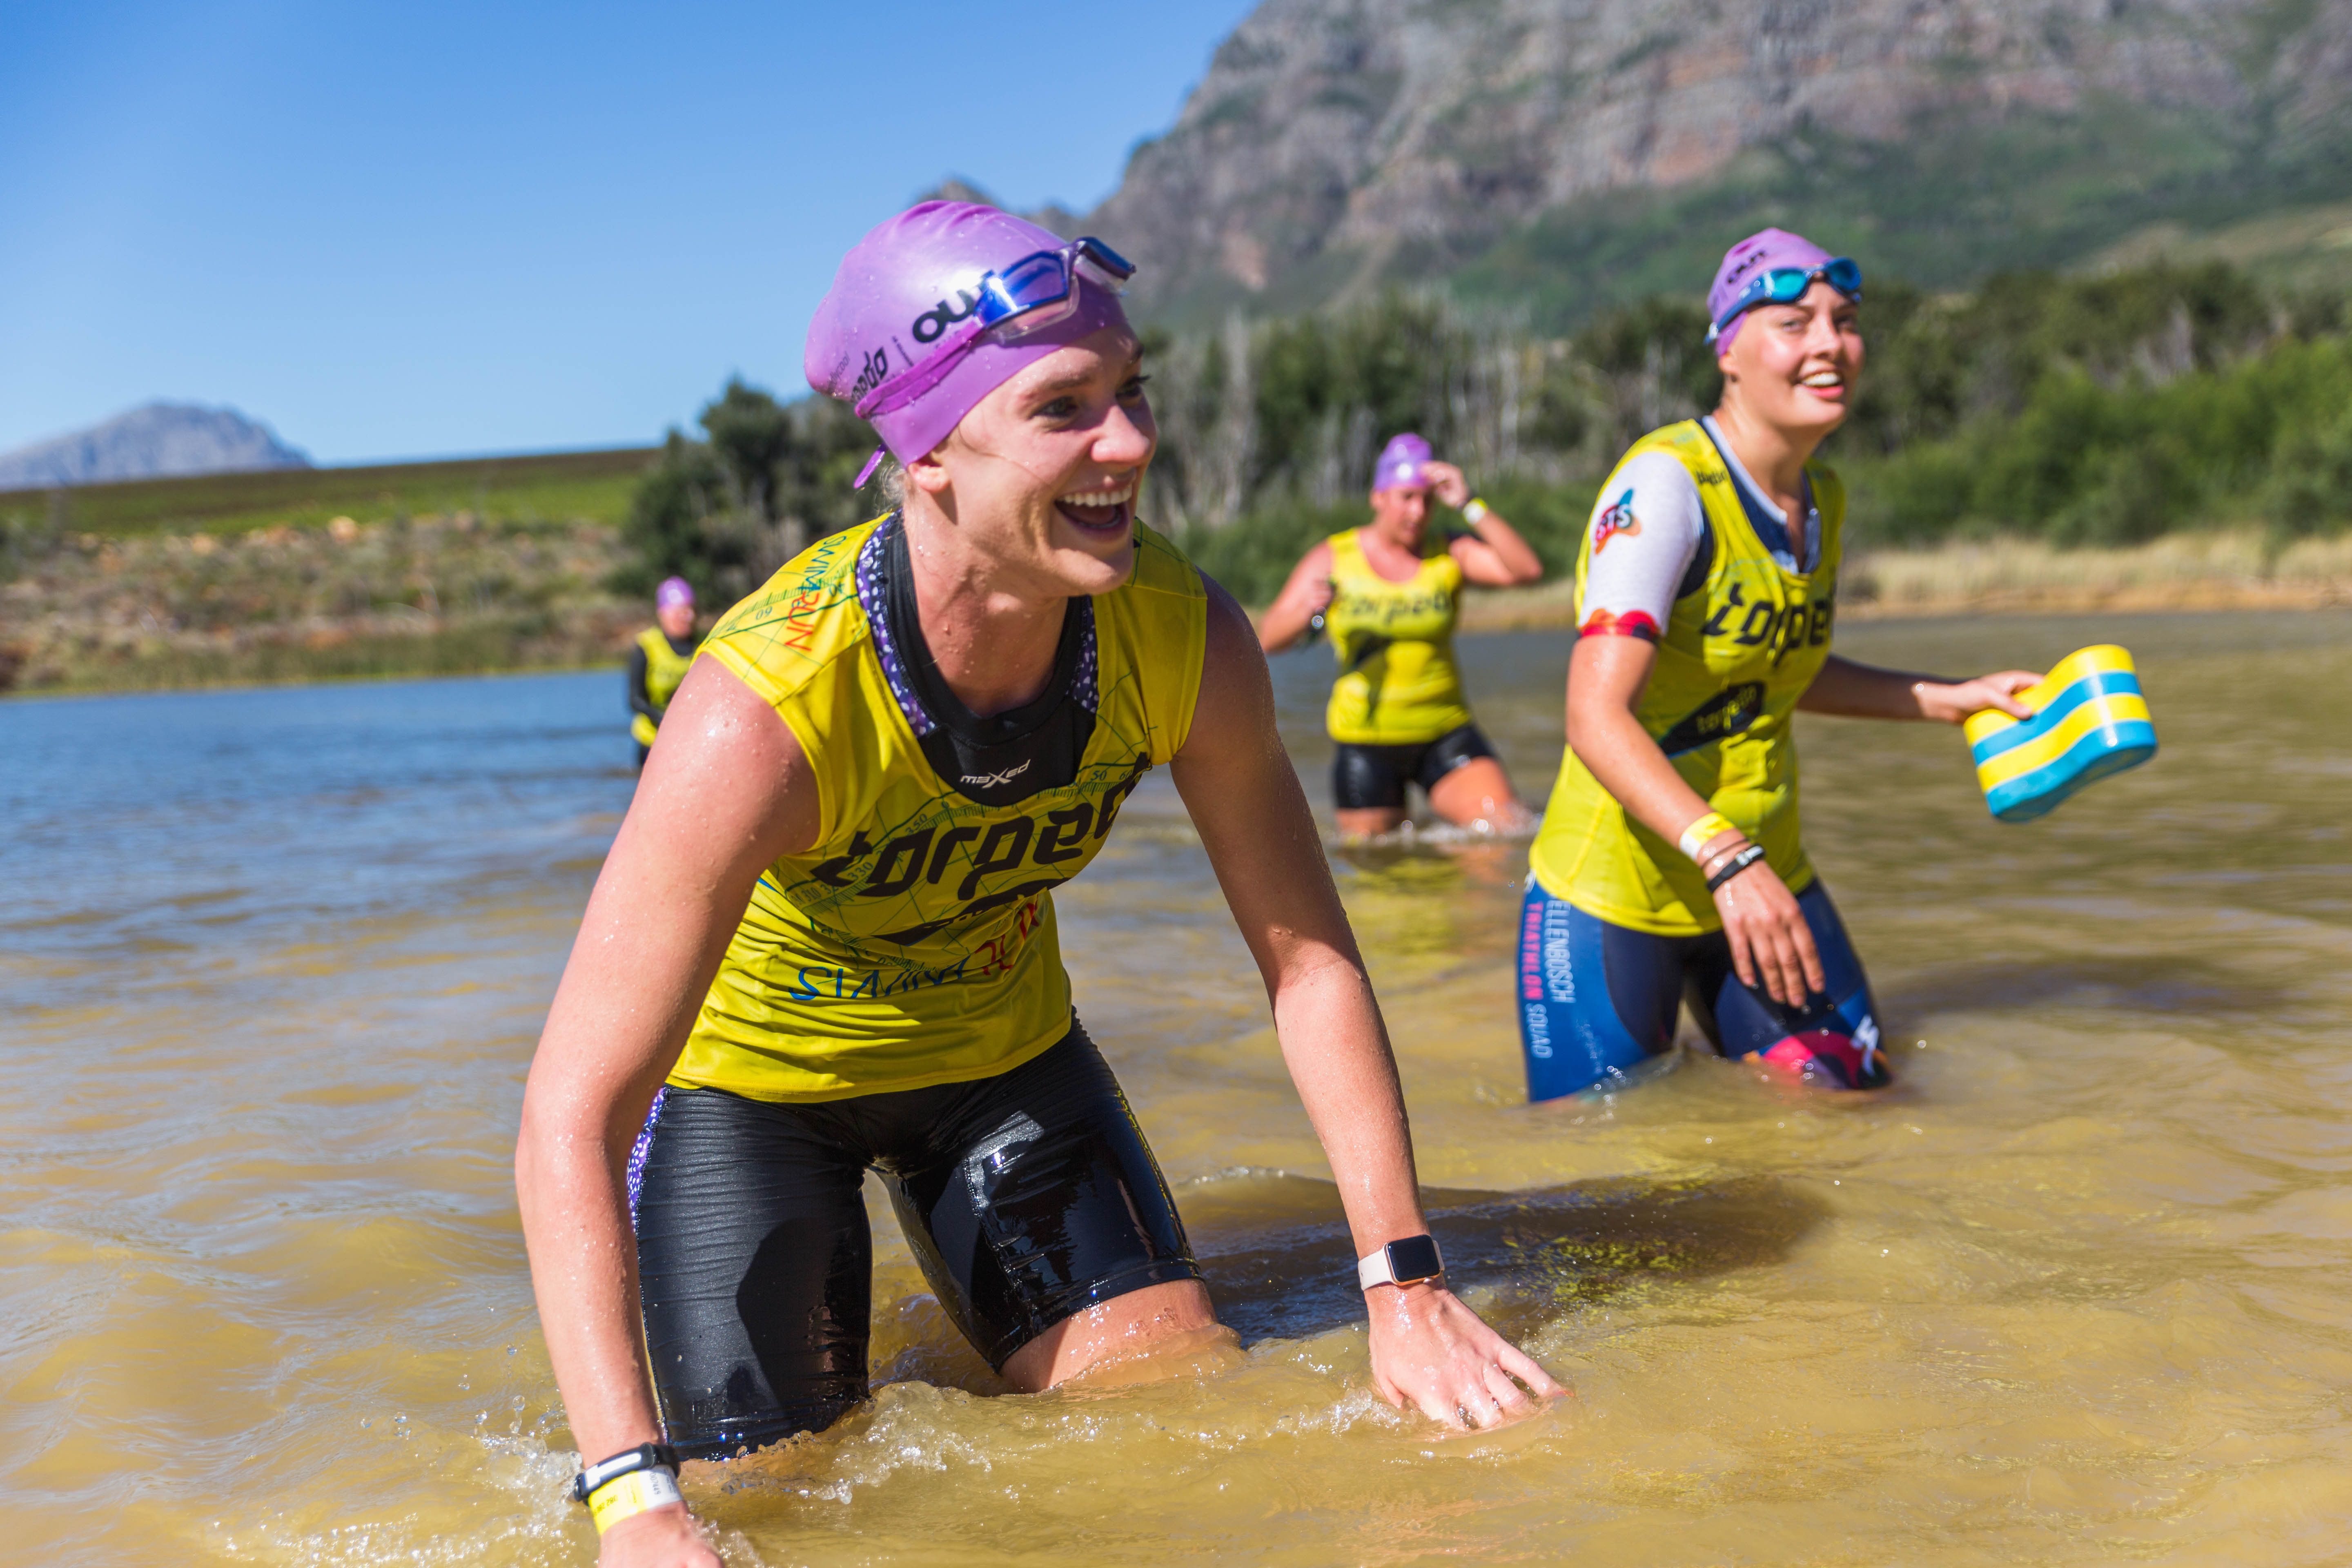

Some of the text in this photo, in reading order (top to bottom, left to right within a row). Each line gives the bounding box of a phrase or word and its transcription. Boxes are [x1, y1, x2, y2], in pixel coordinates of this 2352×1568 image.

[1090, 770, 1107, 782] 50
[811, 752, 1149, 900] torped
[1544, 899, 1577, 1003] ELLENBOSCH
[1525, 1002, 1553, 1059] SQUAD
